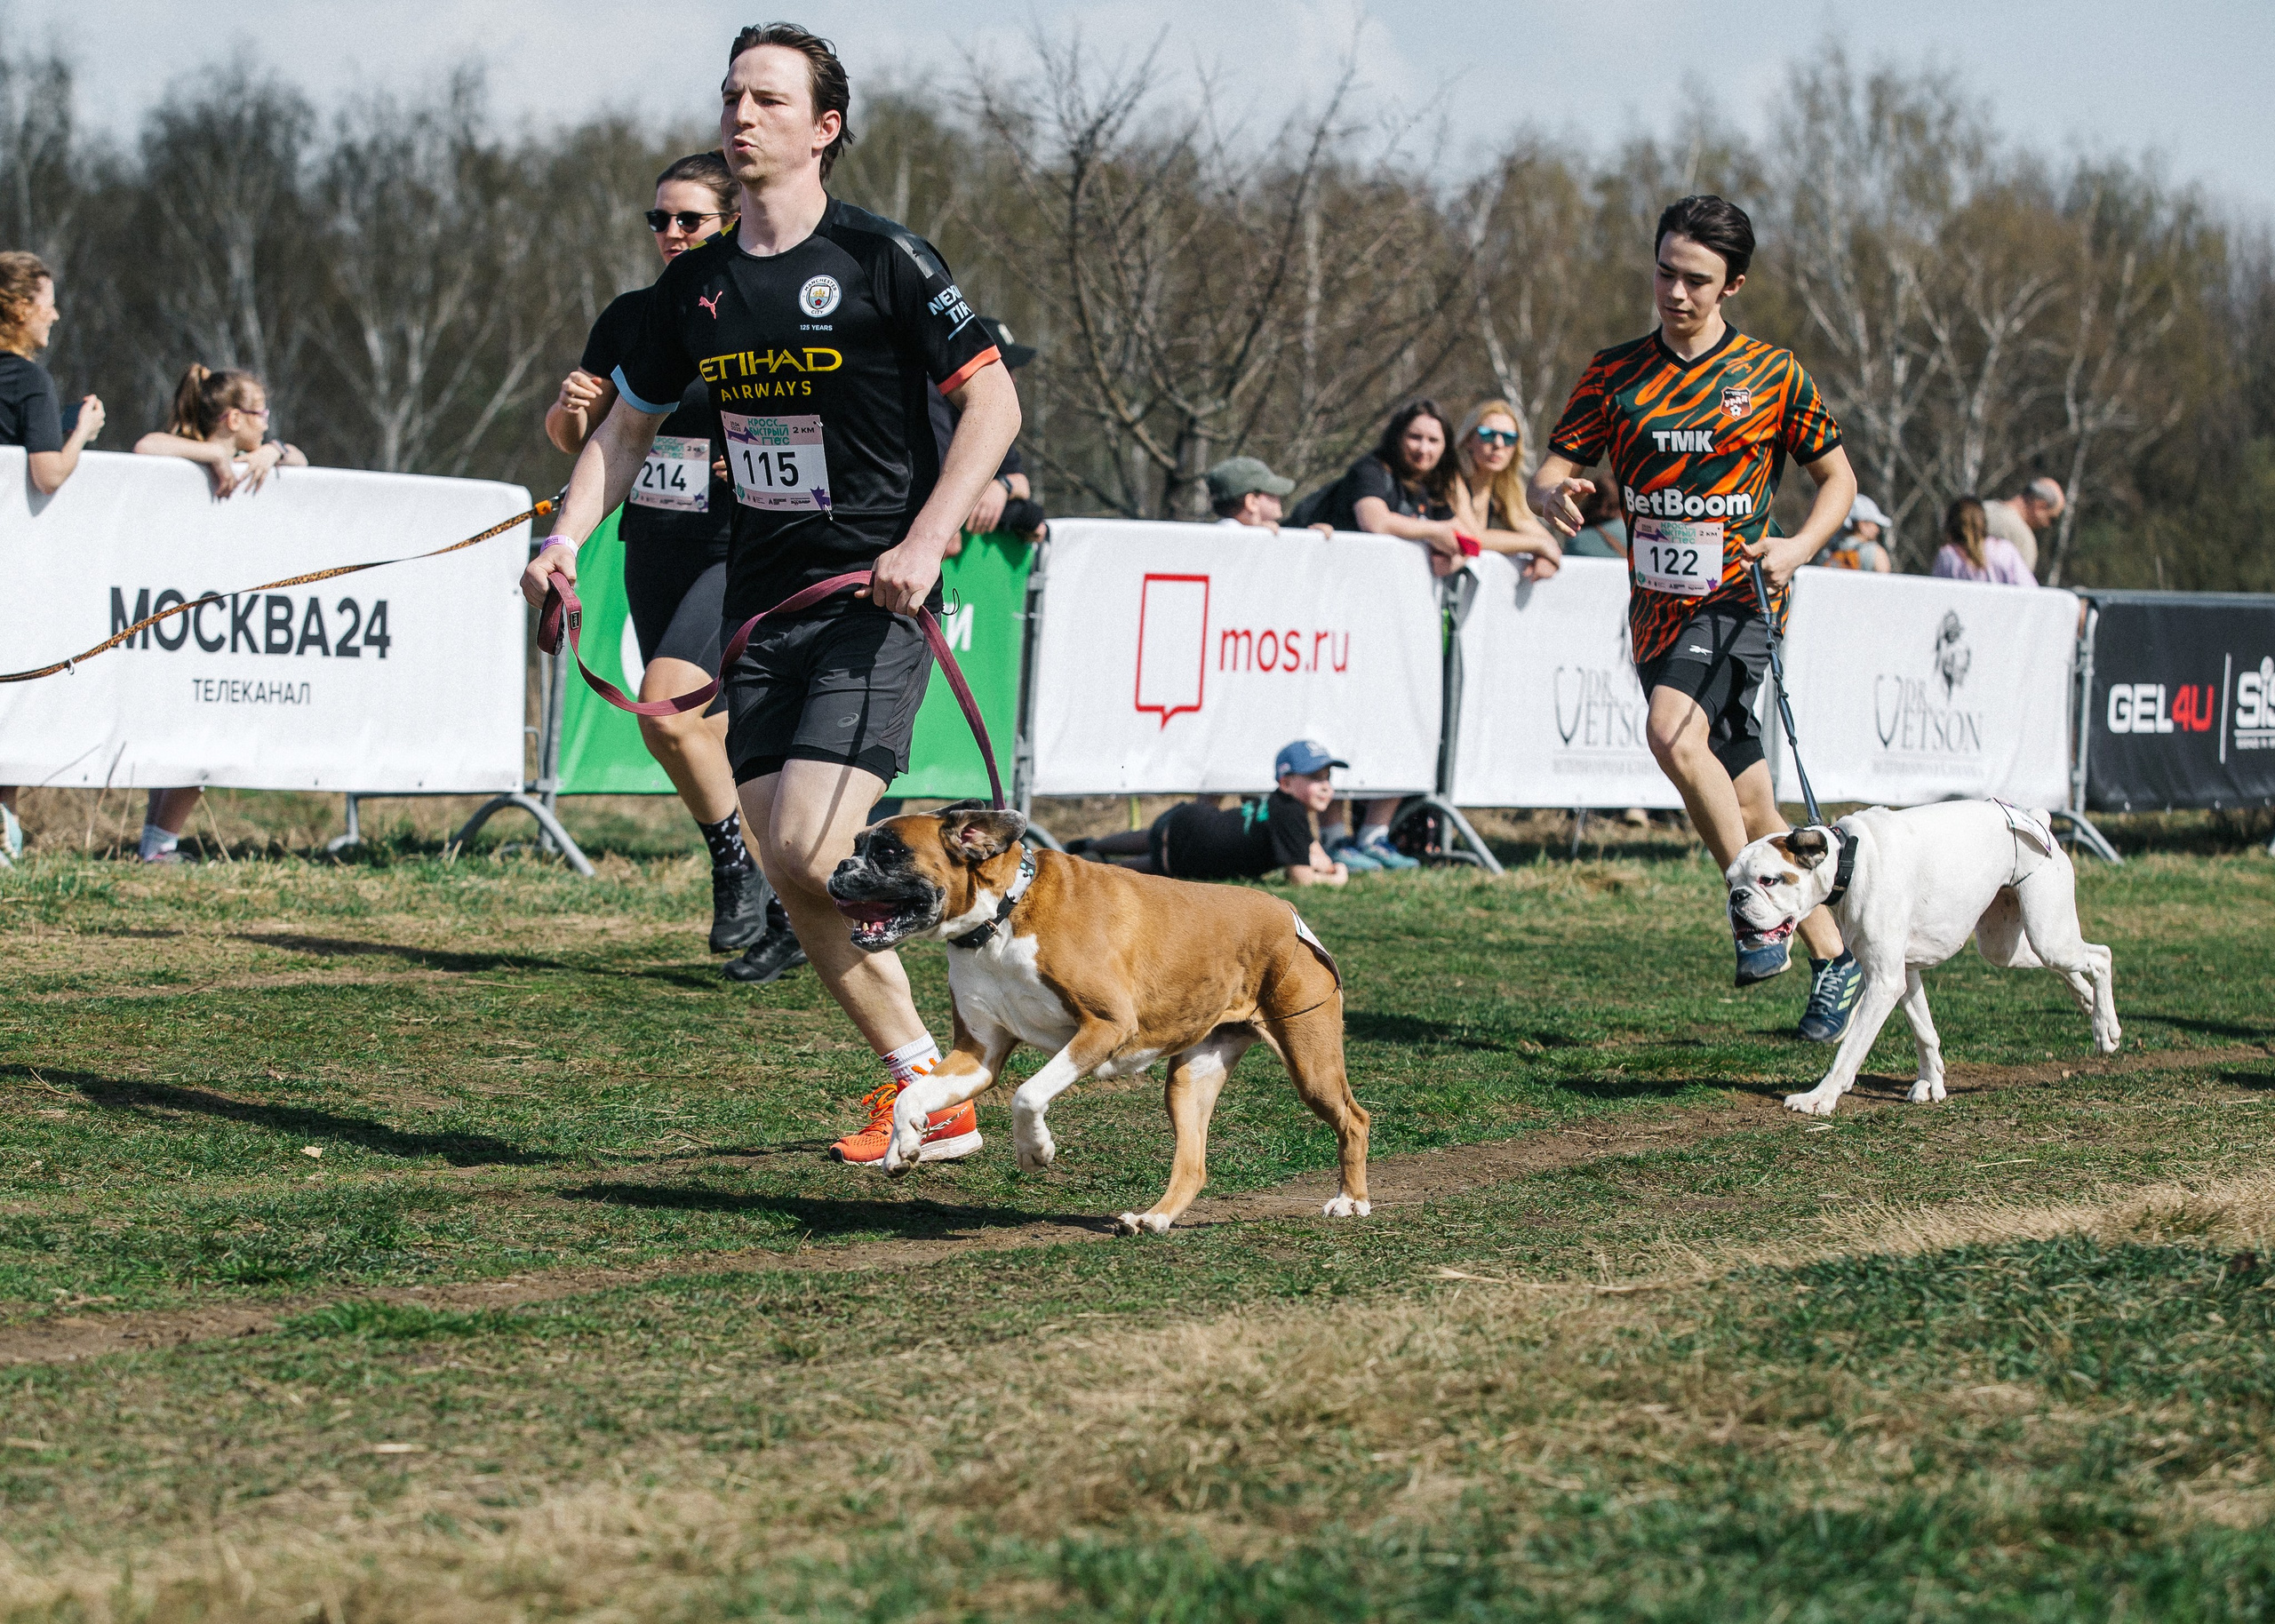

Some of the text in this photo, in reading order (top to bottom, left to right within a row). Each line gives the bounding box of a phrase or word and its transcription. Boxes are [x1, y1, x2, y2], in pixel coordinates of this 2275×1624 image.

[804, 278, 837, 292] MANCHESTER
[927, 283, 962, 316] NEX
[945, 300, 972, 324] TIR
[698, 347, 843, 383] ETIHAD
[721, 380, 812, 402] AIRWAYS
[642, 460, 686, 491] 214
[742, 450, 799, 487] 115
[1624, 484, 1752, 518] BetBoom
[1649, 545, 1698, 577] 122
[1218, 627, 1350, 673] mos.ru
[192, 679, 311, 705] ТЕЛЕКАНАЛ
[2107, 682, 2215, 734] GEL4U
